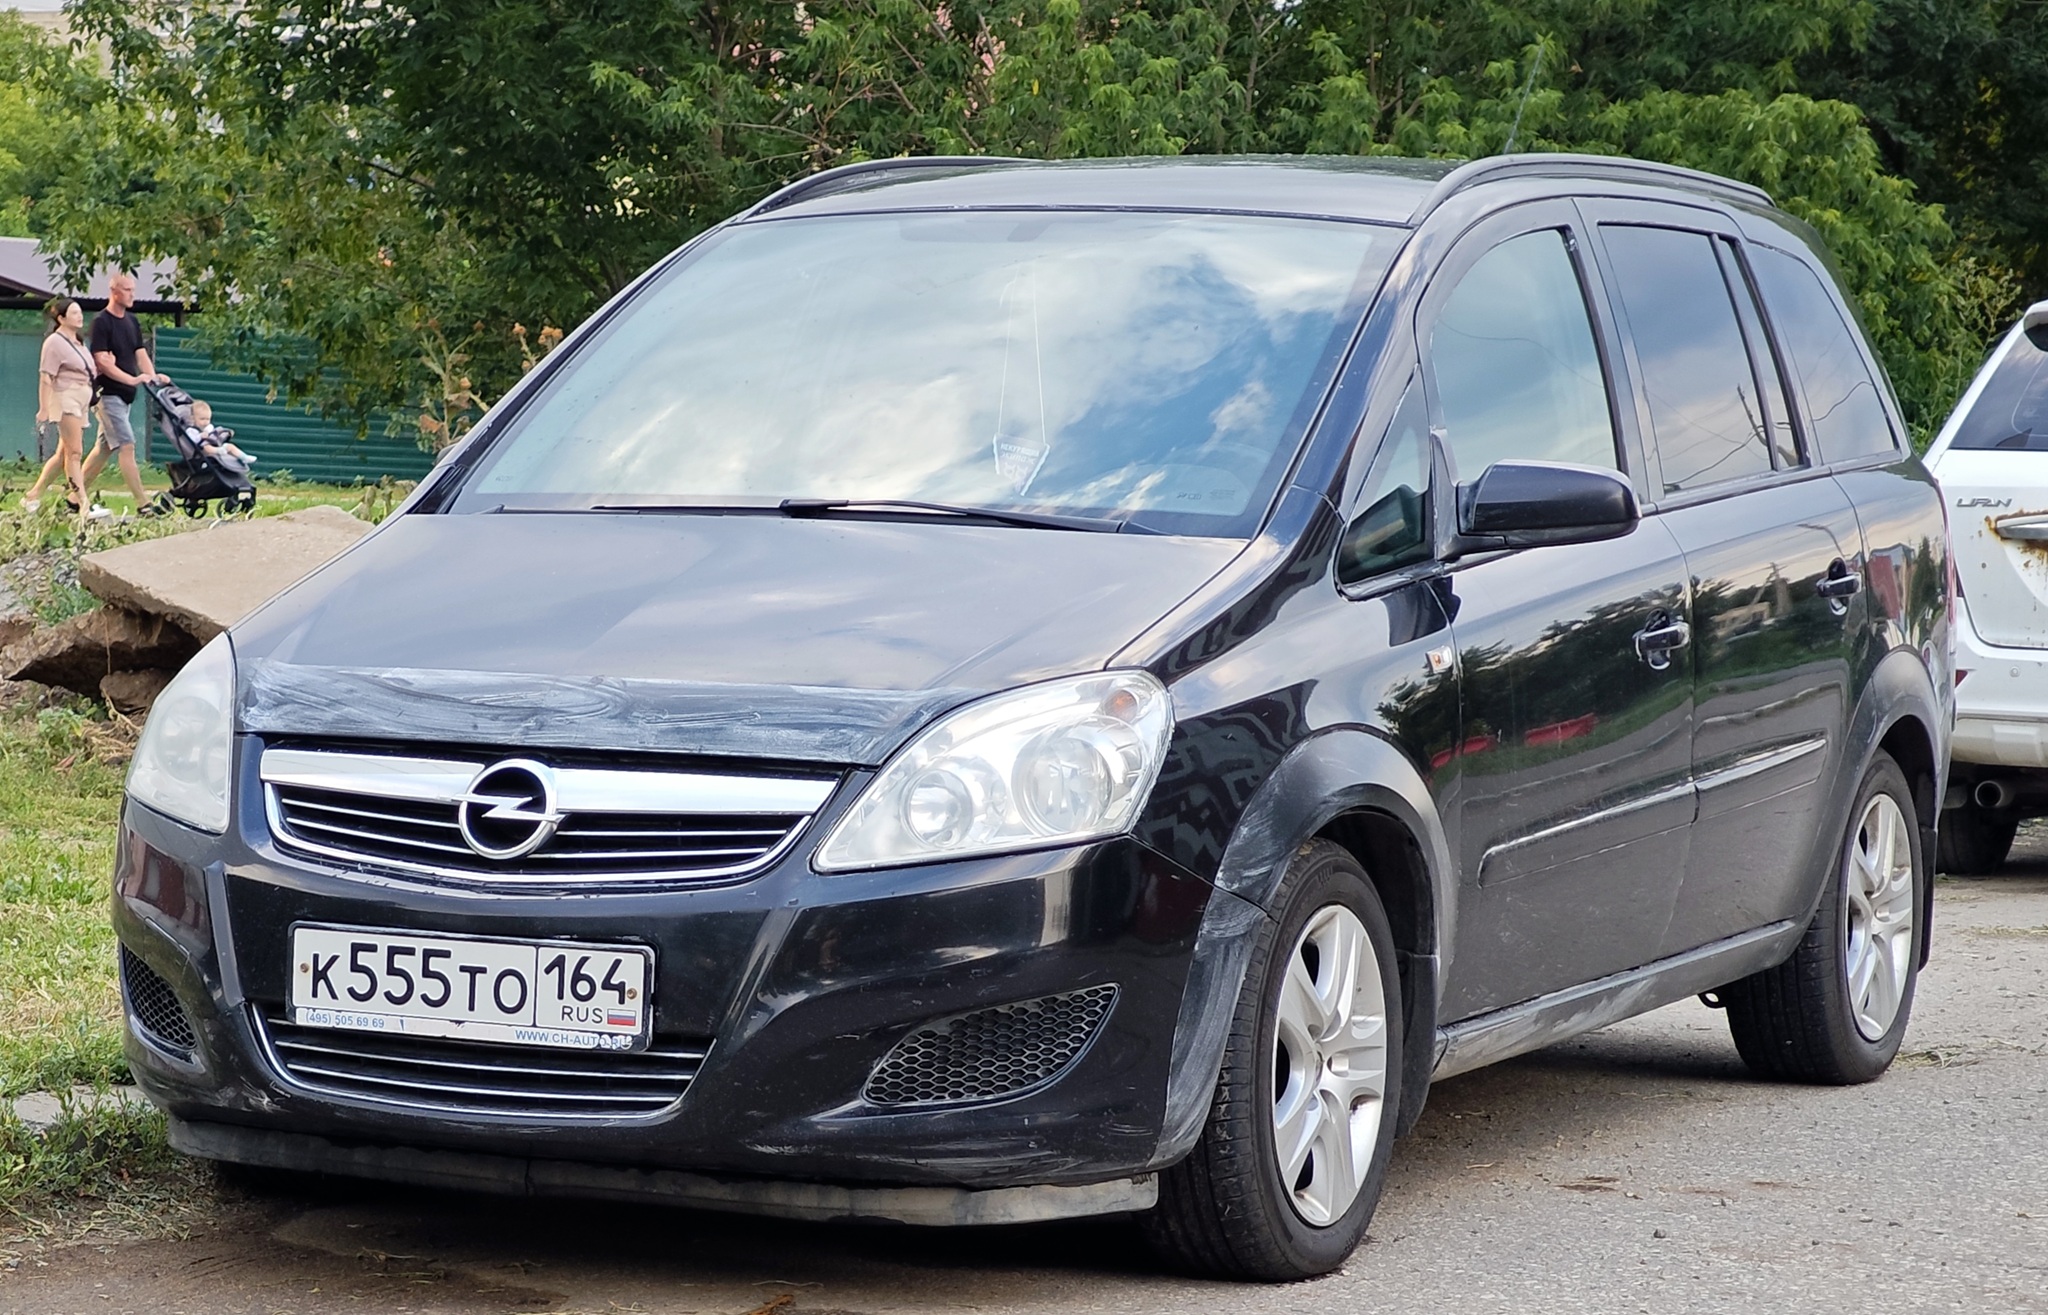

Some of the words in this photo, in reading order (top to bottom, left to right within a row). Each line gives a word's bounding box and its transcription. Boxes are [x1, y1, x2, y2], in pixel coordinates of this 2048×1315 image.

[311, 942, 528, 1014] К555ТО
[544, 953, 625, 1005] 164
[306, 1011, 331, 1024] (495)
[335, 1015, 353, 1026] 505
[356, 1018, 369, 1027] 69
[372, 1018, 385, 1028] 69
[561, 1005, 603, 1023] RUS
